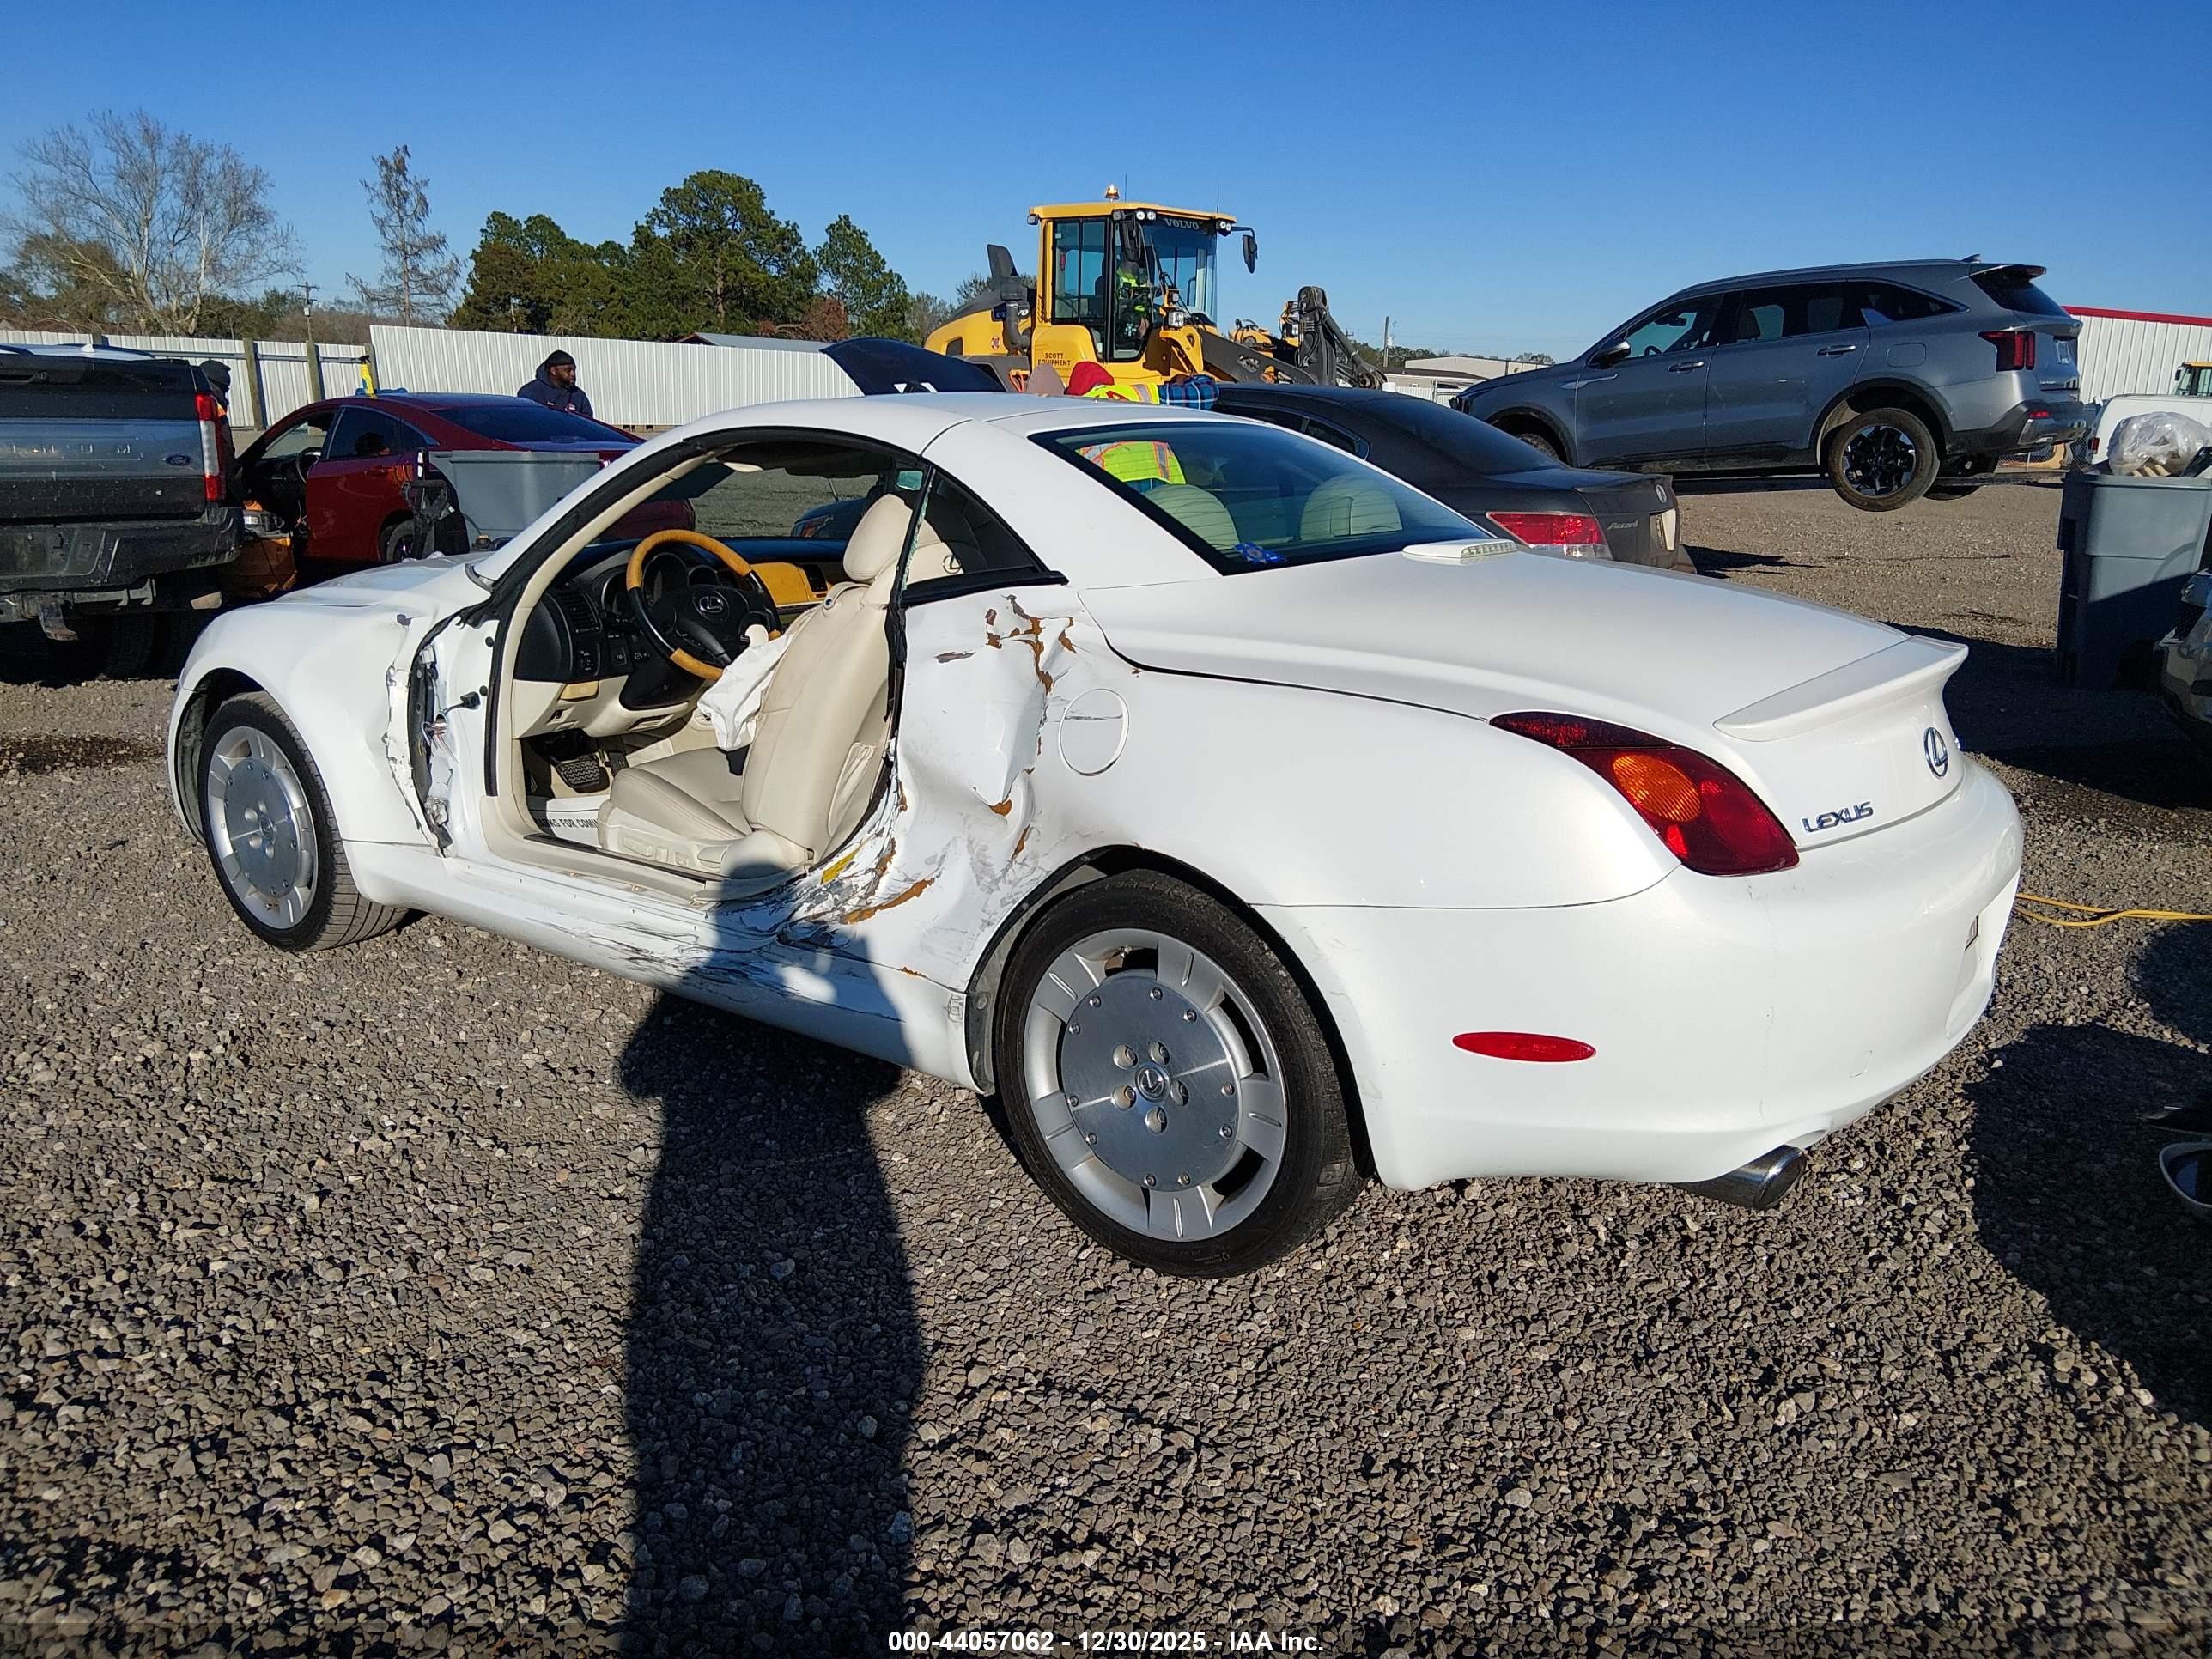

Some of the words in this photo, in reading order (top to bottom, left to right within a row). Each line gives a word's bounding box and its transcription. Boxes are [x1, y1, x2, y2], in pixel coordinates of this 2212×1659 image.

[1164, 218, 1200, 230] VOLVO
[1607, 520, 1638, 530] Accord
[1802, 801, 1874, 832] LEXUS
[559, 818, 576, 829] FOR
